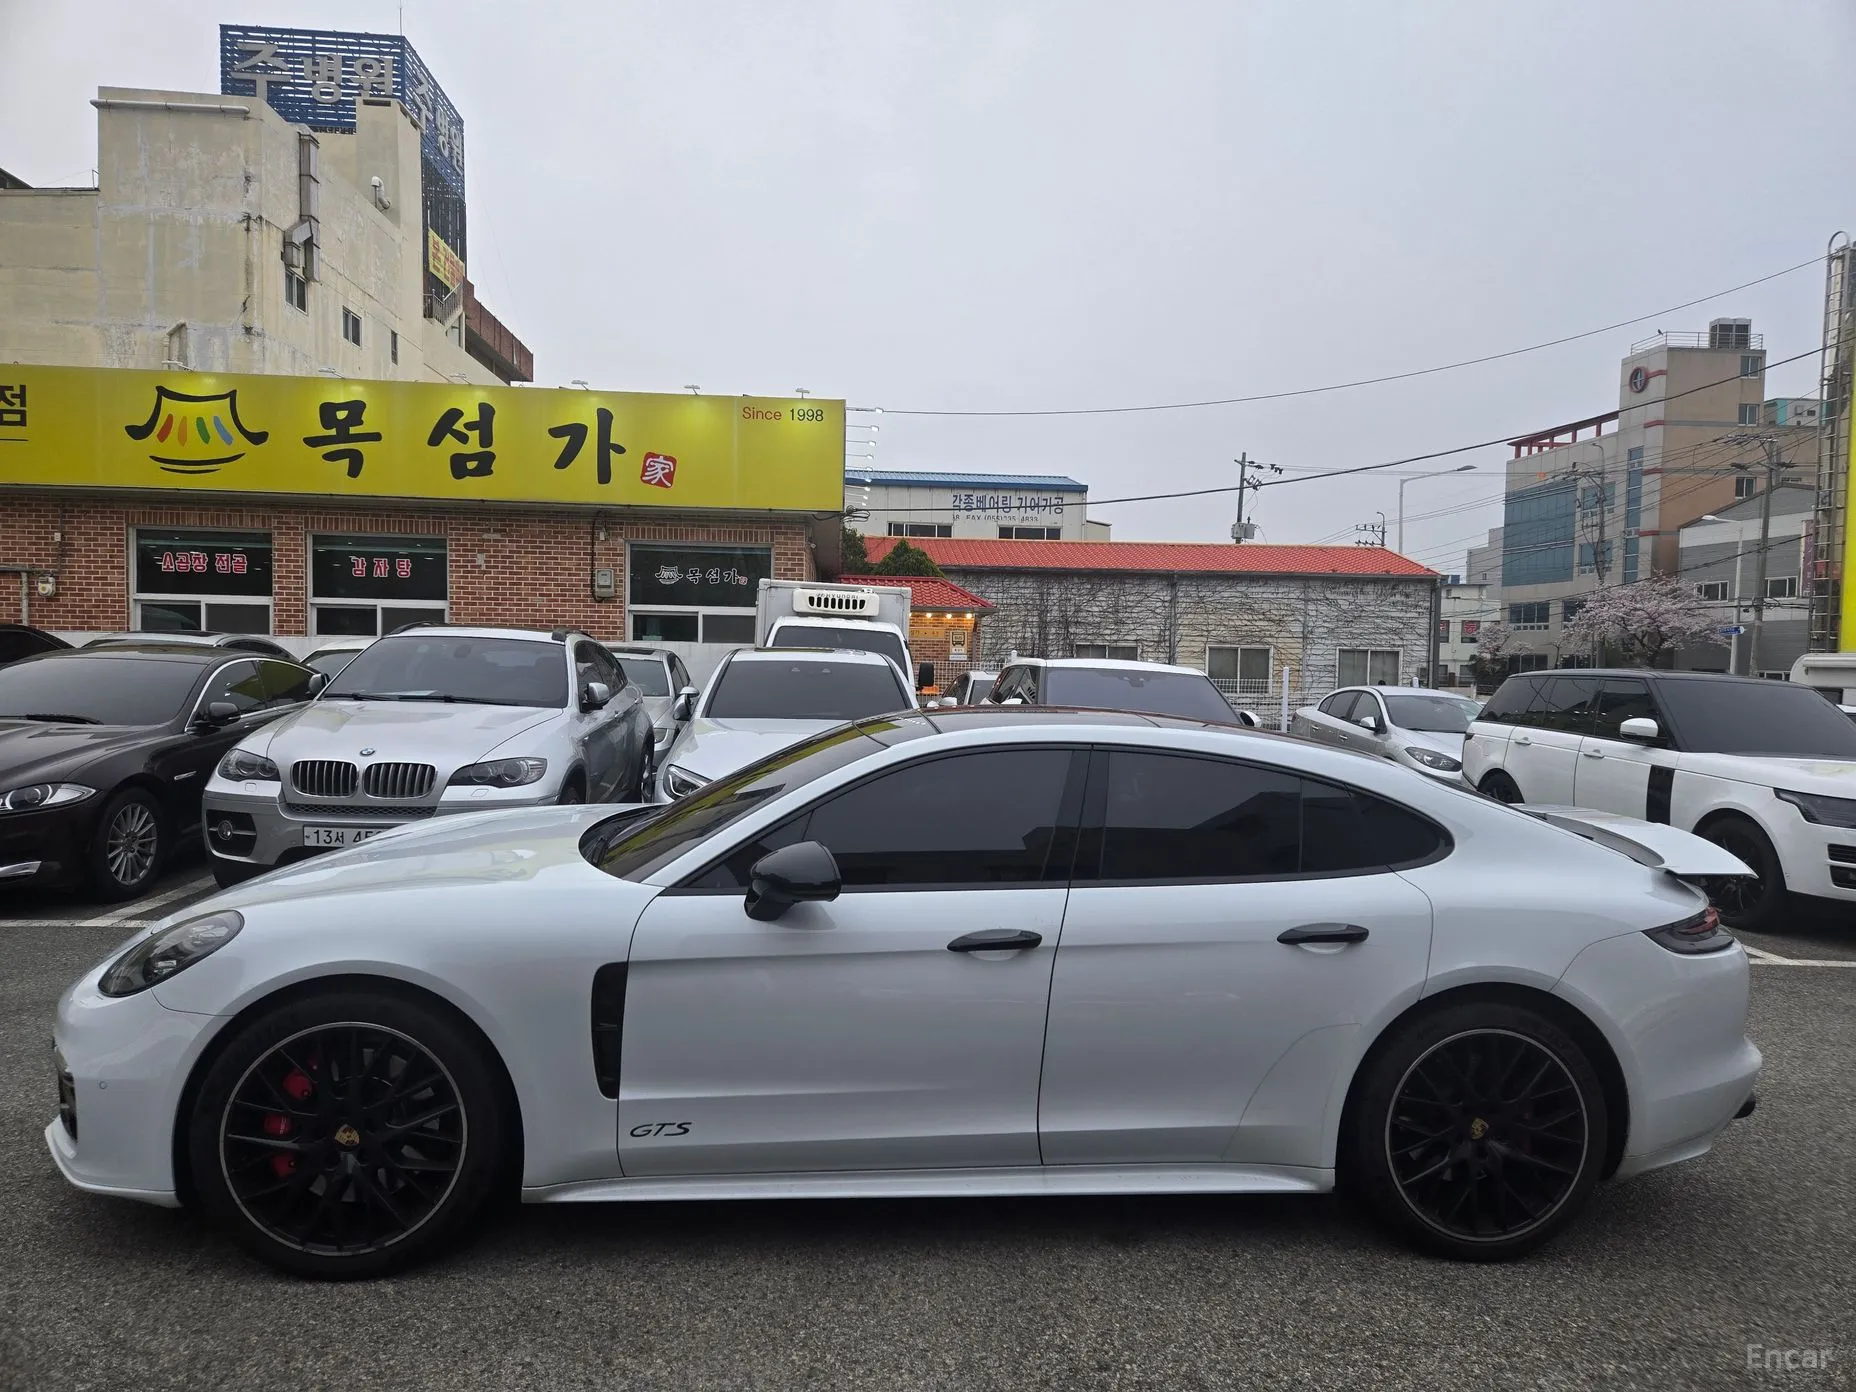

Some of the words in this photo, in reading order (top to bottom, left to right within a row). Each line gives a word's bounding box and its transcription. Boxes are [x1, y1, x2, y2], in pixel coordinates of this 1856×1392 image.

[742, 406, 782, 421] Since
[790, 408, 824, 422] 1998
[952, 493, 1012, 514] 각종베어링
[215, 554, 248, 573] 전골
[313, 829, 344, 844] 13서
[629, 1122, 692, 1137] GTS
